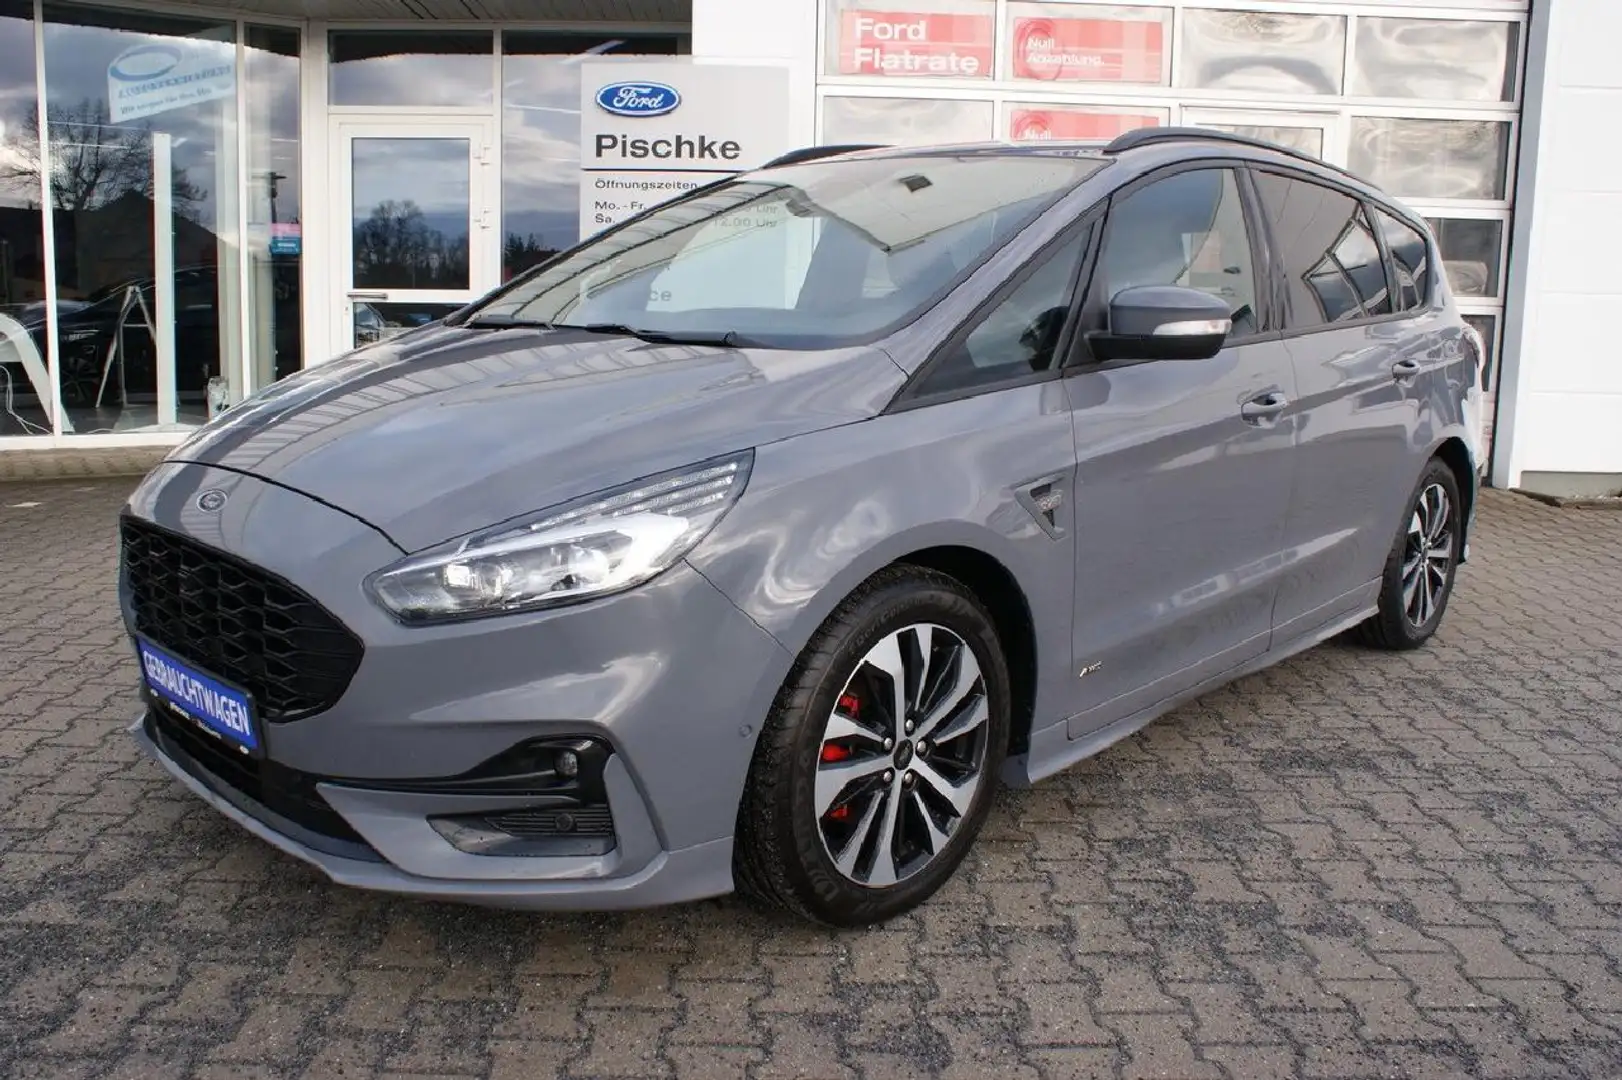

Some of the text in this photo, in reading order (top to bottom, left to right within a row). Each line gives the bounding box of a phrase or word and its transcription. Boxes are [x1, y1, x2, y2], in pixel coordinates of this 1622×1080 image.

[855, 18, 927, 40] Ford
[854, 47, 980, 74] Flatrate
[613, 86, 664, 108] Ford
[596, 134, 741, 160] Pischke
[595, 178, 698, 190] Öffnungszeiten
[595, 213, 616, 224] Sa.
[143, 650, 250, 737] GEBRAUCHTWAGEN
